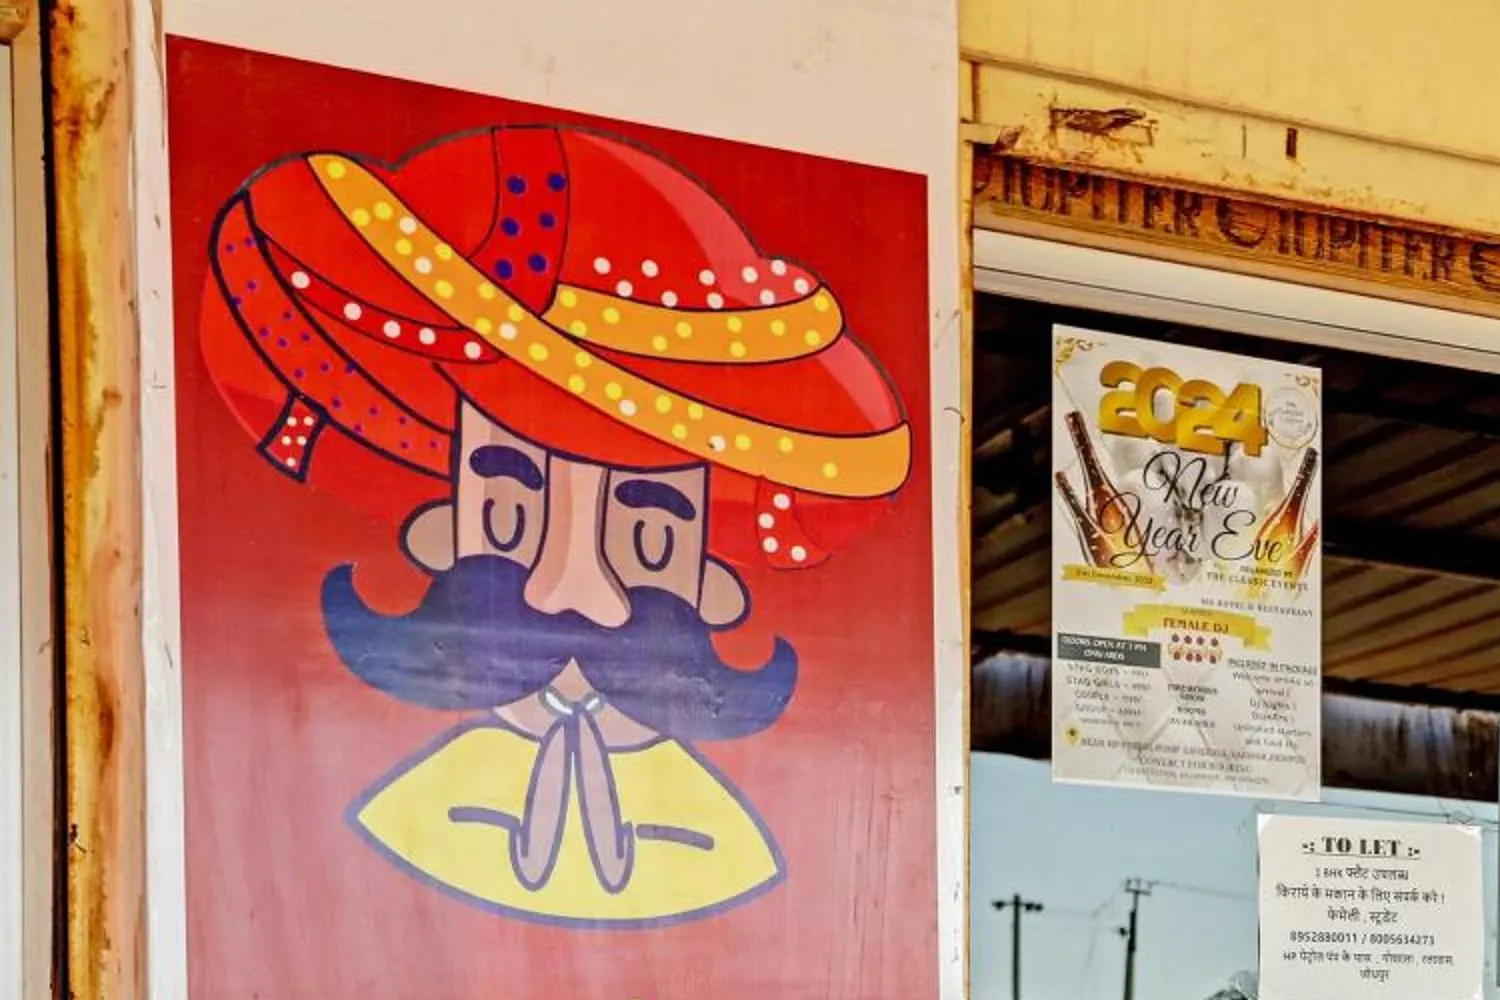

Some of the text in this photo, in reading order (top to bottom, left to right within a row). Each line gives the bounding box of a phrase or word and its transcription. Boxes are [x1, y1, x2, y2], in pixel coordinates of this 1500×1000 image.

[1097, 360, 1268, 457] 2024
[1143, 450, 1239, 512] New
[1100, 491, 1283, 568] Year Eve
[1163, 617, 1230, 634] FEMALE DJ
[1321, 837, 1353, 853] TO
[1358, 839, 1402, 856] LET
